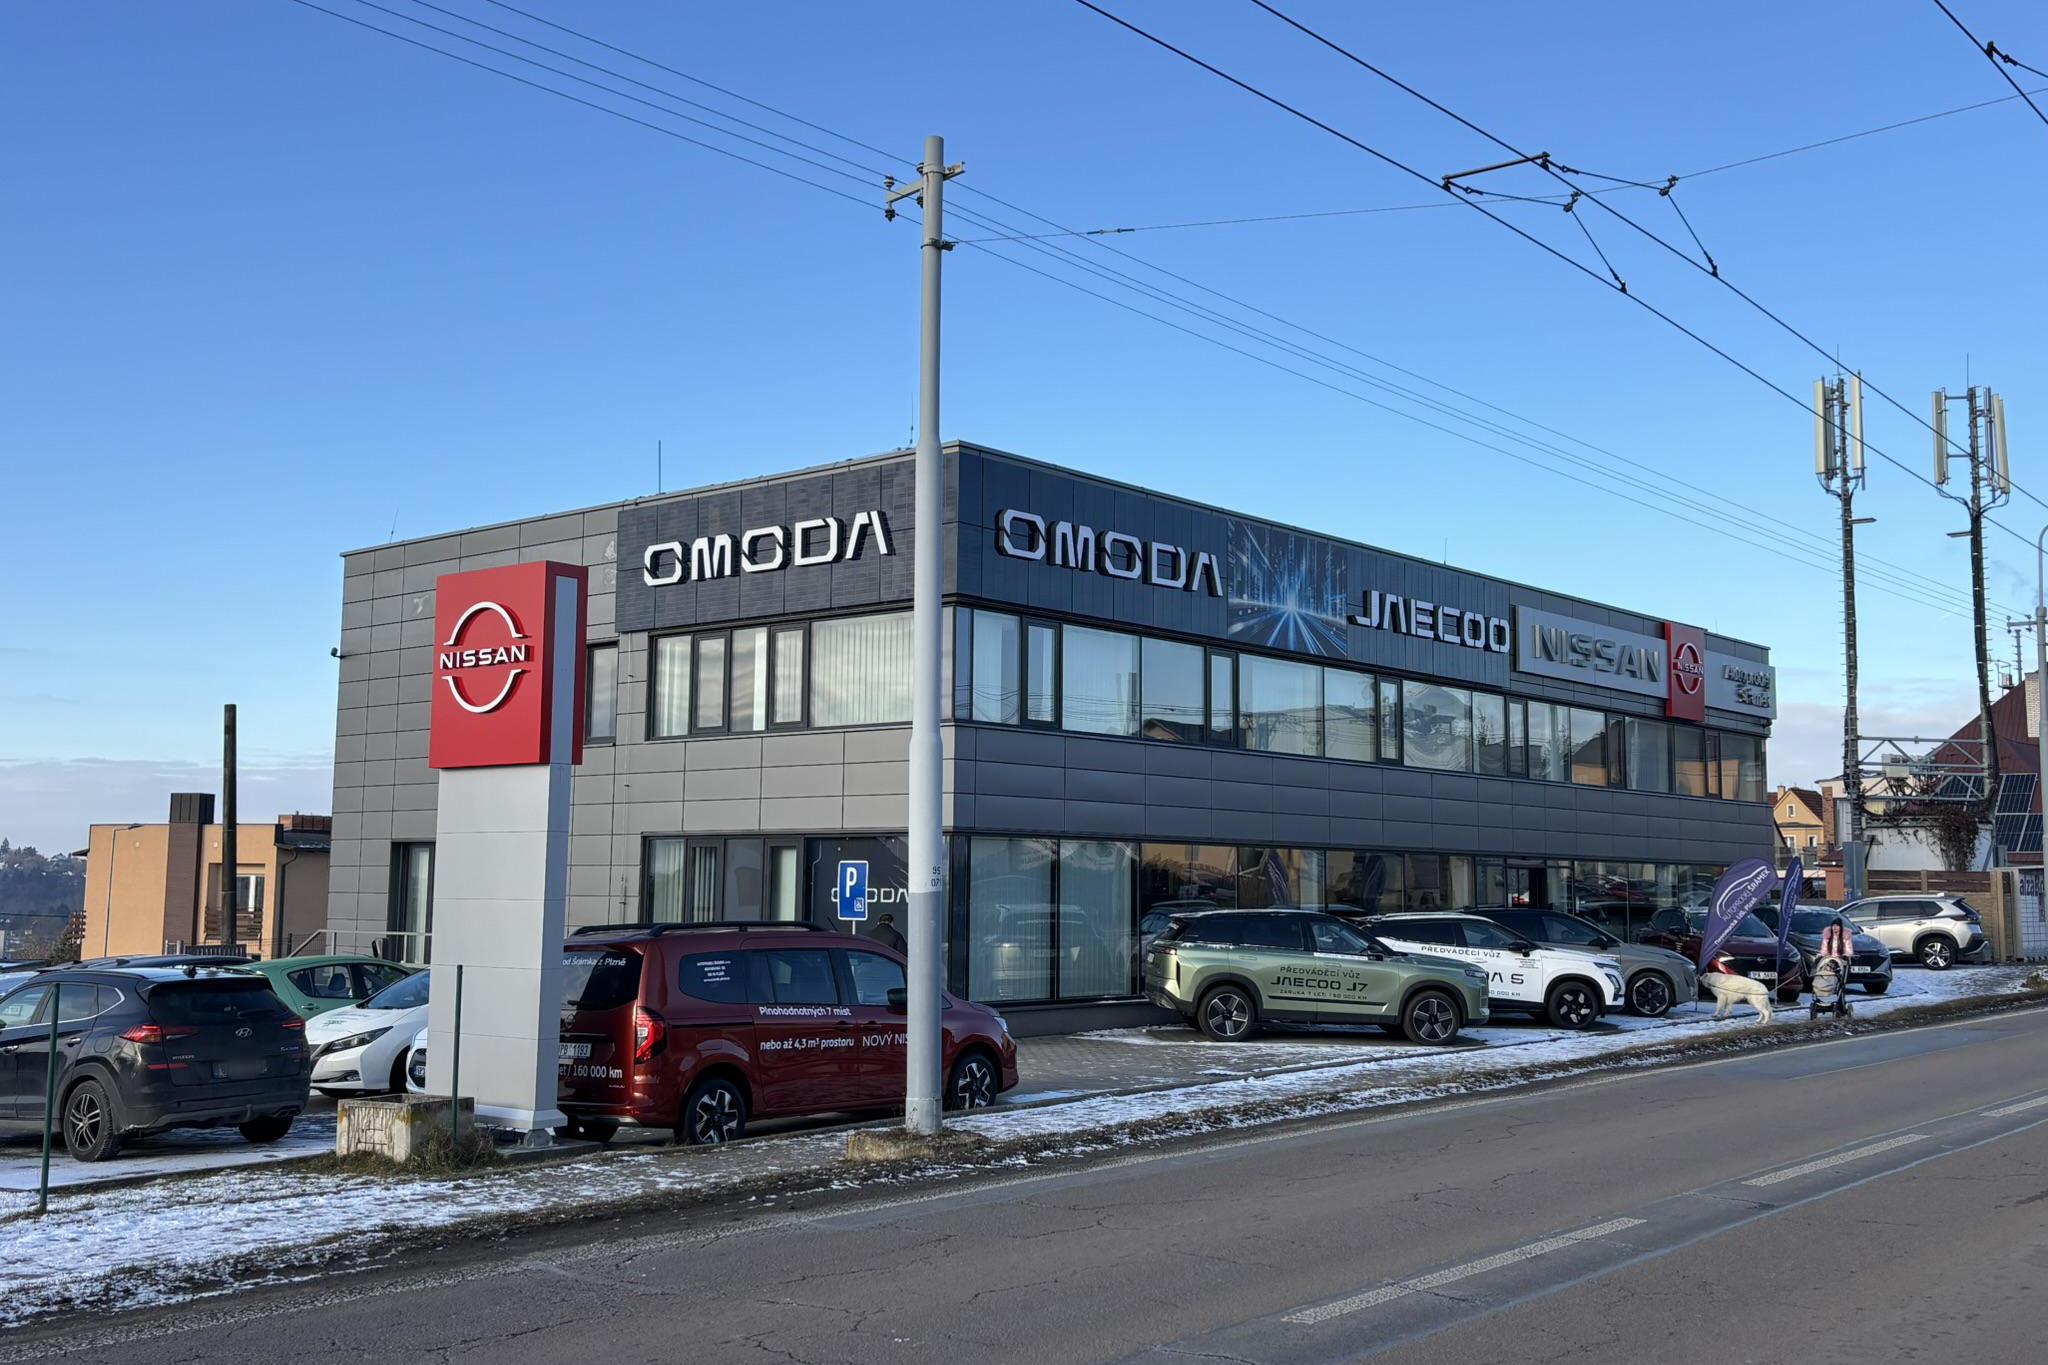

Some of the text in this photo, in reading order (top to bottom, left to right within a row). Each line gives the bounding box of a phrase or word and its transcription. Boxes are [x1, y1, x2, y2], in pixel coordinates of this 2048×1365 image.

[643, 510, 889, 586] OMODA
[998, 508, 1224, 597] OMODA
[1349, 589, 1511, 654] JAECOO
[439, 643, 526, 670] NISSAN
[1533, 624, 1661, 682] NISSAN
[1677, 660, 1704, 676] NISSAN
[845, 867, 857, 898] P
[1421, 945, 1502, 959] PŘEDVÁDĚCÍ VŮZ
[604, 956, 626, 966] Plzně
[1279, 966, 1361, 979] PŘEDVÁDĚCÍ VŮZ
[1270, 976, 1369, 992] JAECOO J7
[760, 1039, 782, 1051] nebo
[783, 1037, 793, 1049] až
[794, 1038, 807, 1051] 4,3
[820, 1037, 854, 1050] prostoru
[862, 1031, 893, 1048] NOVÝ
[573, 1065, 588, 1077] 160
[590, 1065, 607, 1078] 000
[609, 1066, 623, 1079] km
